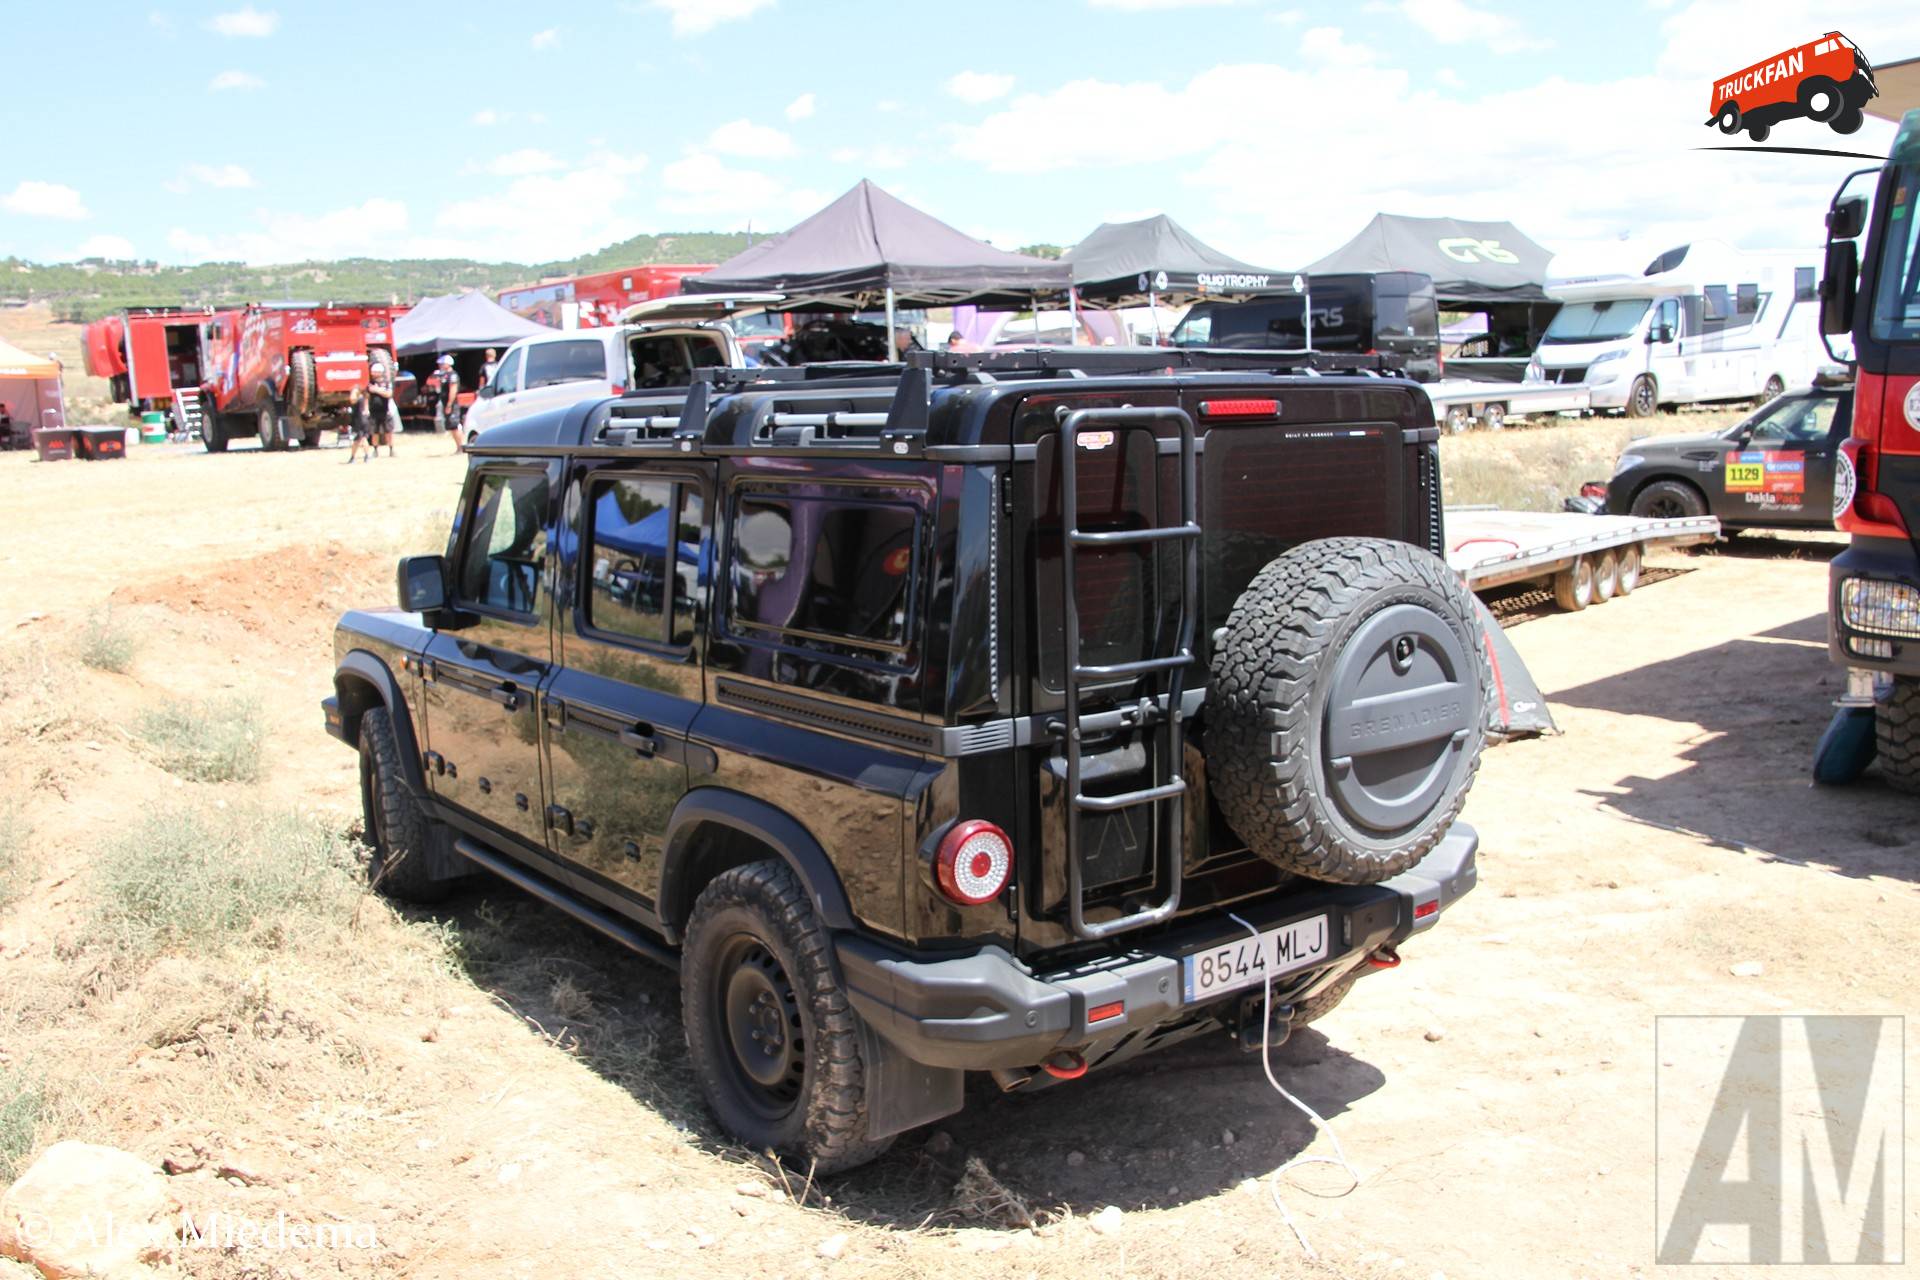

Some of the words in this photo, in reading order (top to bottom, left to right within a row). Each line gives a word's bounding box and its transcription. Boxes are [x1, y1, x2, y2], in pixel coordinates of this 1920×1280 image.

[1730, 467, 1760, 481] 1129
[1350, 702, 1461, 740] GRENADIER
[1200, 942, 1265, 988] 8544
[1277, 921, 1322, 966] MLJ
